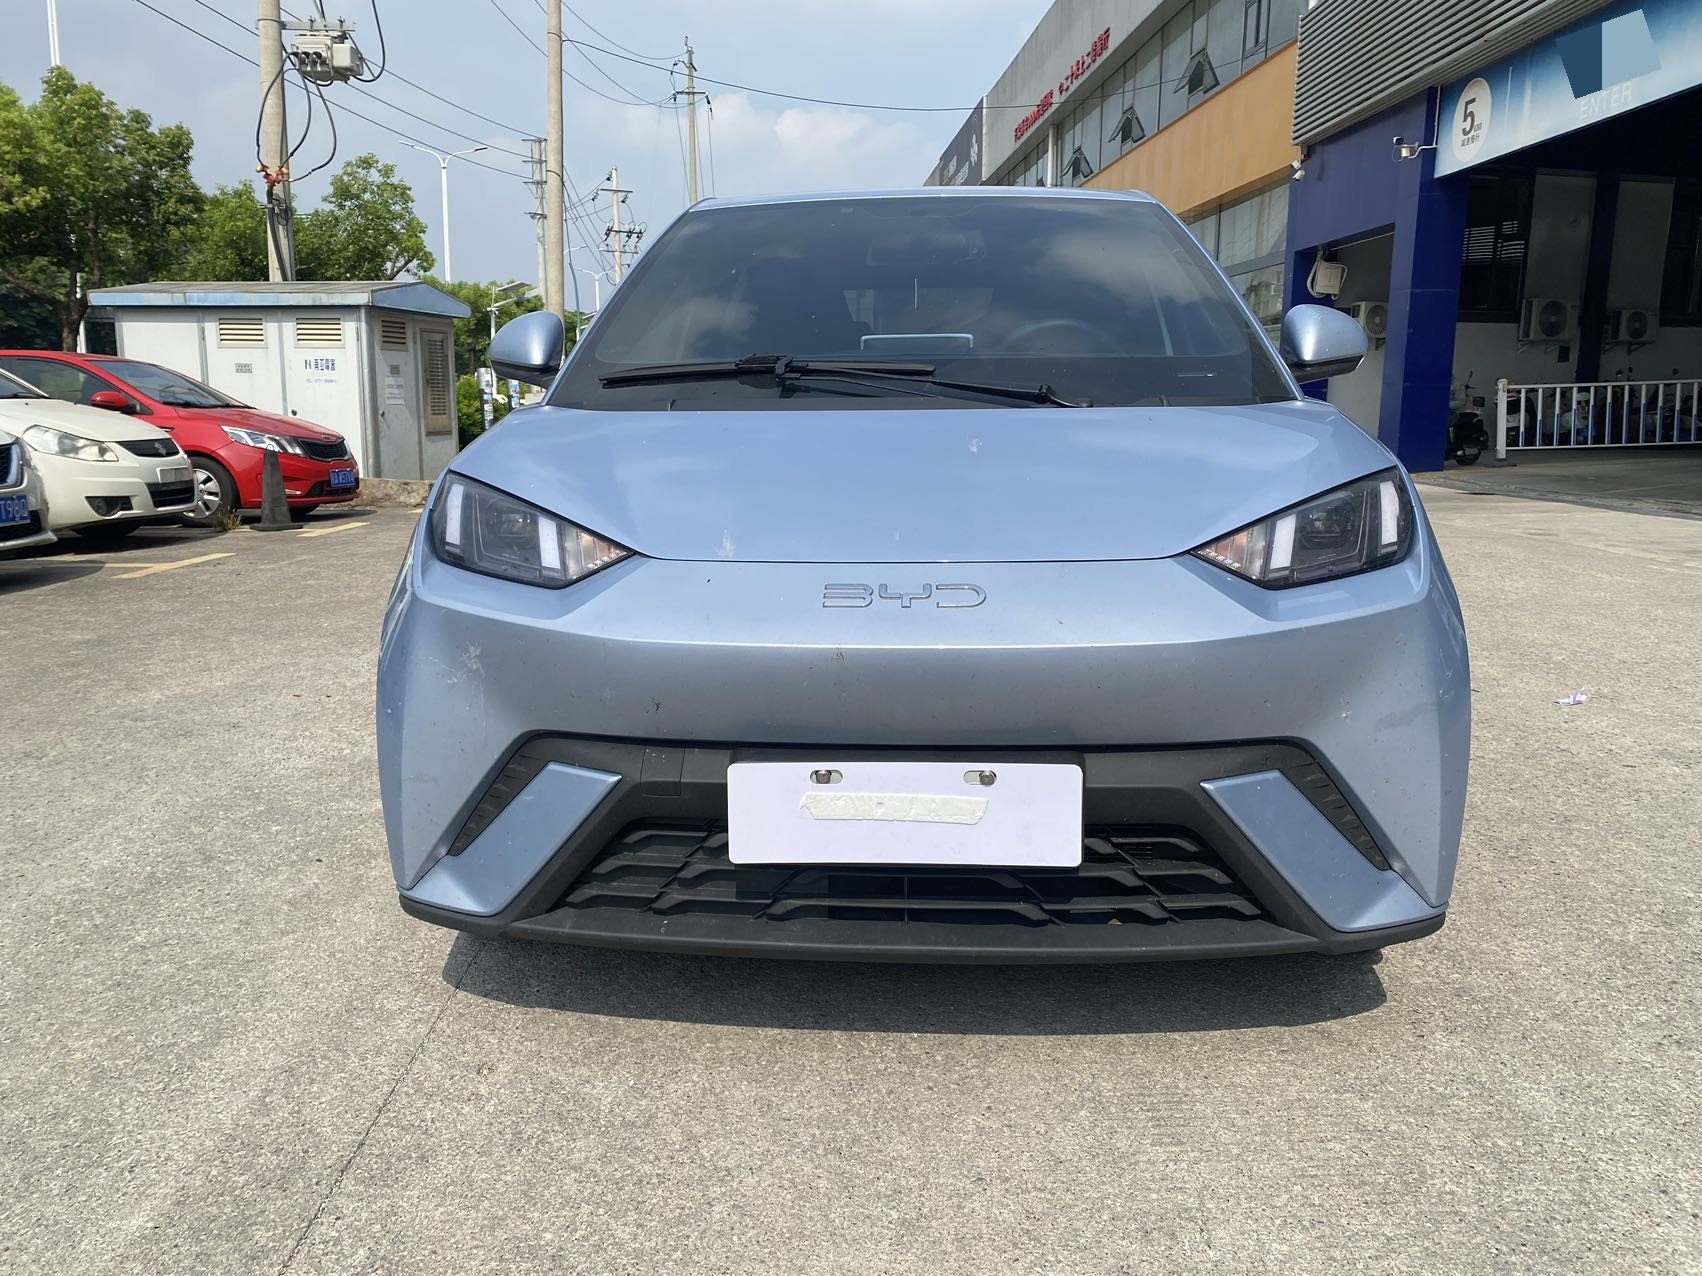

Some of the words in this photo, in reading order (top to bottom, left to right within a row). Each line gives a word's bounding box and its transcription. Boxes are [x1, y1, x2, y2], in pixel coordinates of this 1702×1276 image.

[1462, 97, 1476, 136] 5
[1579, 81, 1632, 120] ENTER
[823, 583, 987, 608] BYD
